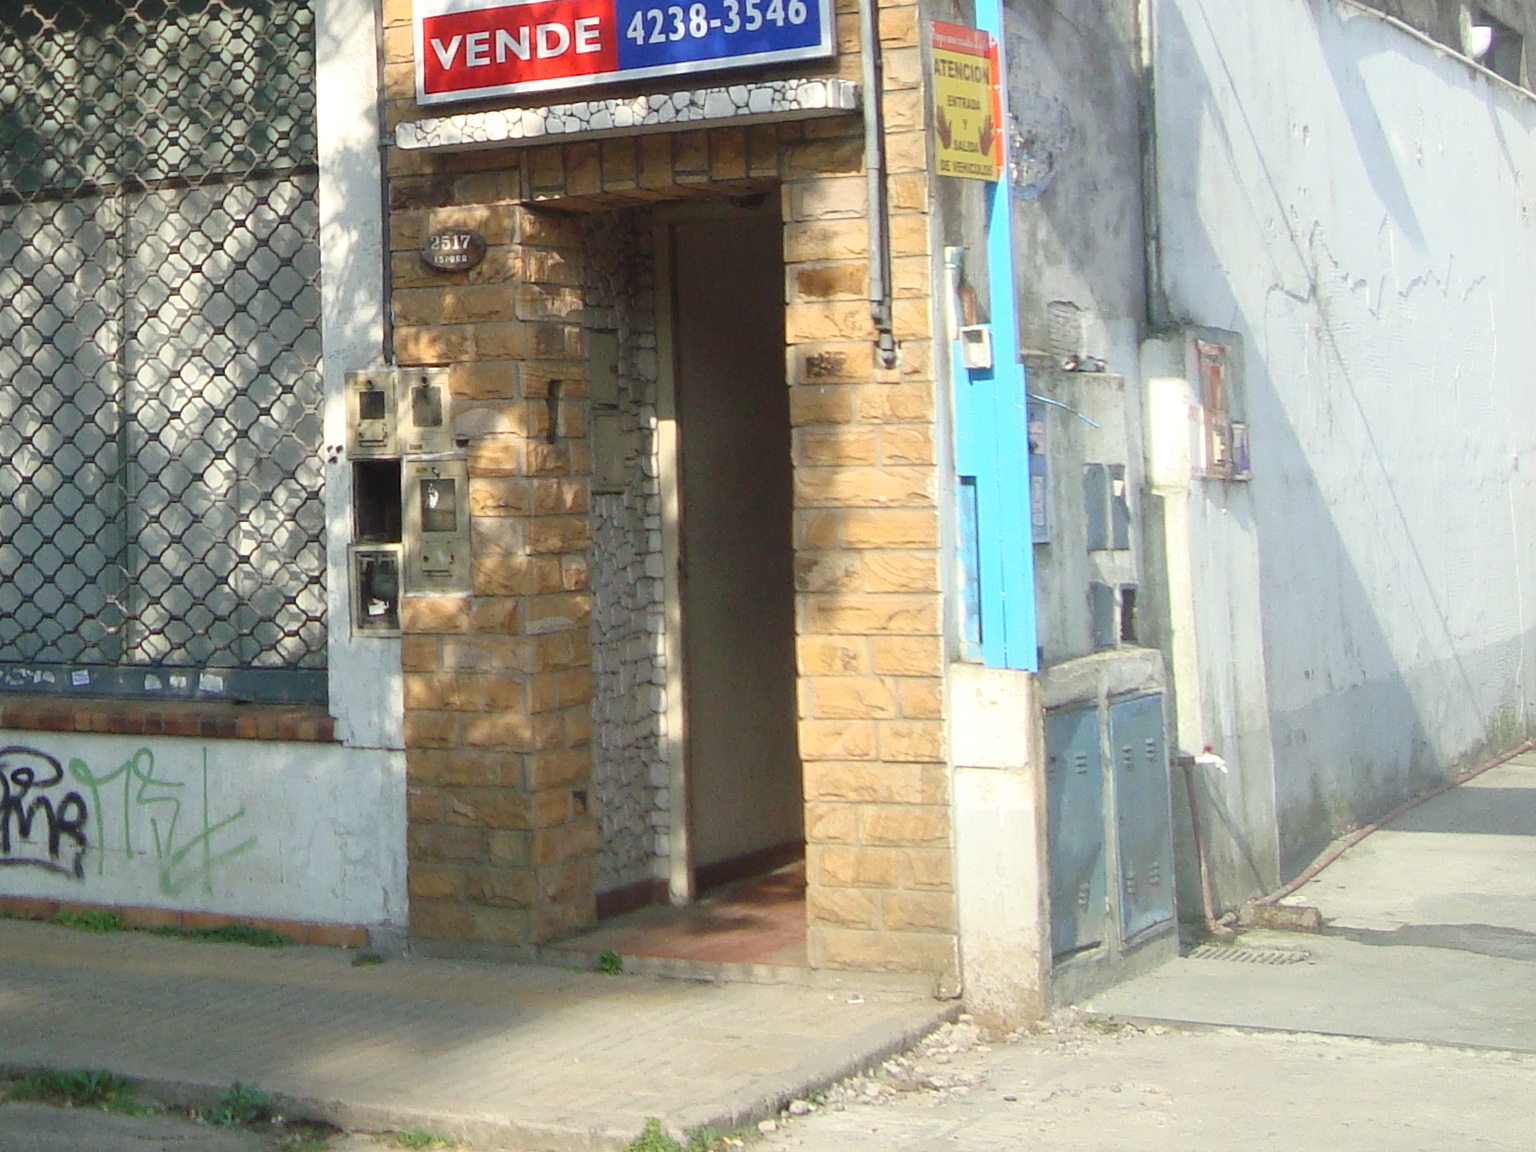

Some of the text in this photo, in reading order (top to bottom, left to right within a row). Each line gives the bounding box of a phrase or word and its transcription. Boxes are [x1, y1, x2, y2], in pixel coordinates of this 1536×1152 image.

[430, 17, 602, 71] VENDE
[934, 57, 989, 84] ATENCION
[947, 94, 981, 110] ENTRADA
[430, 234, 471, 250] 2517
